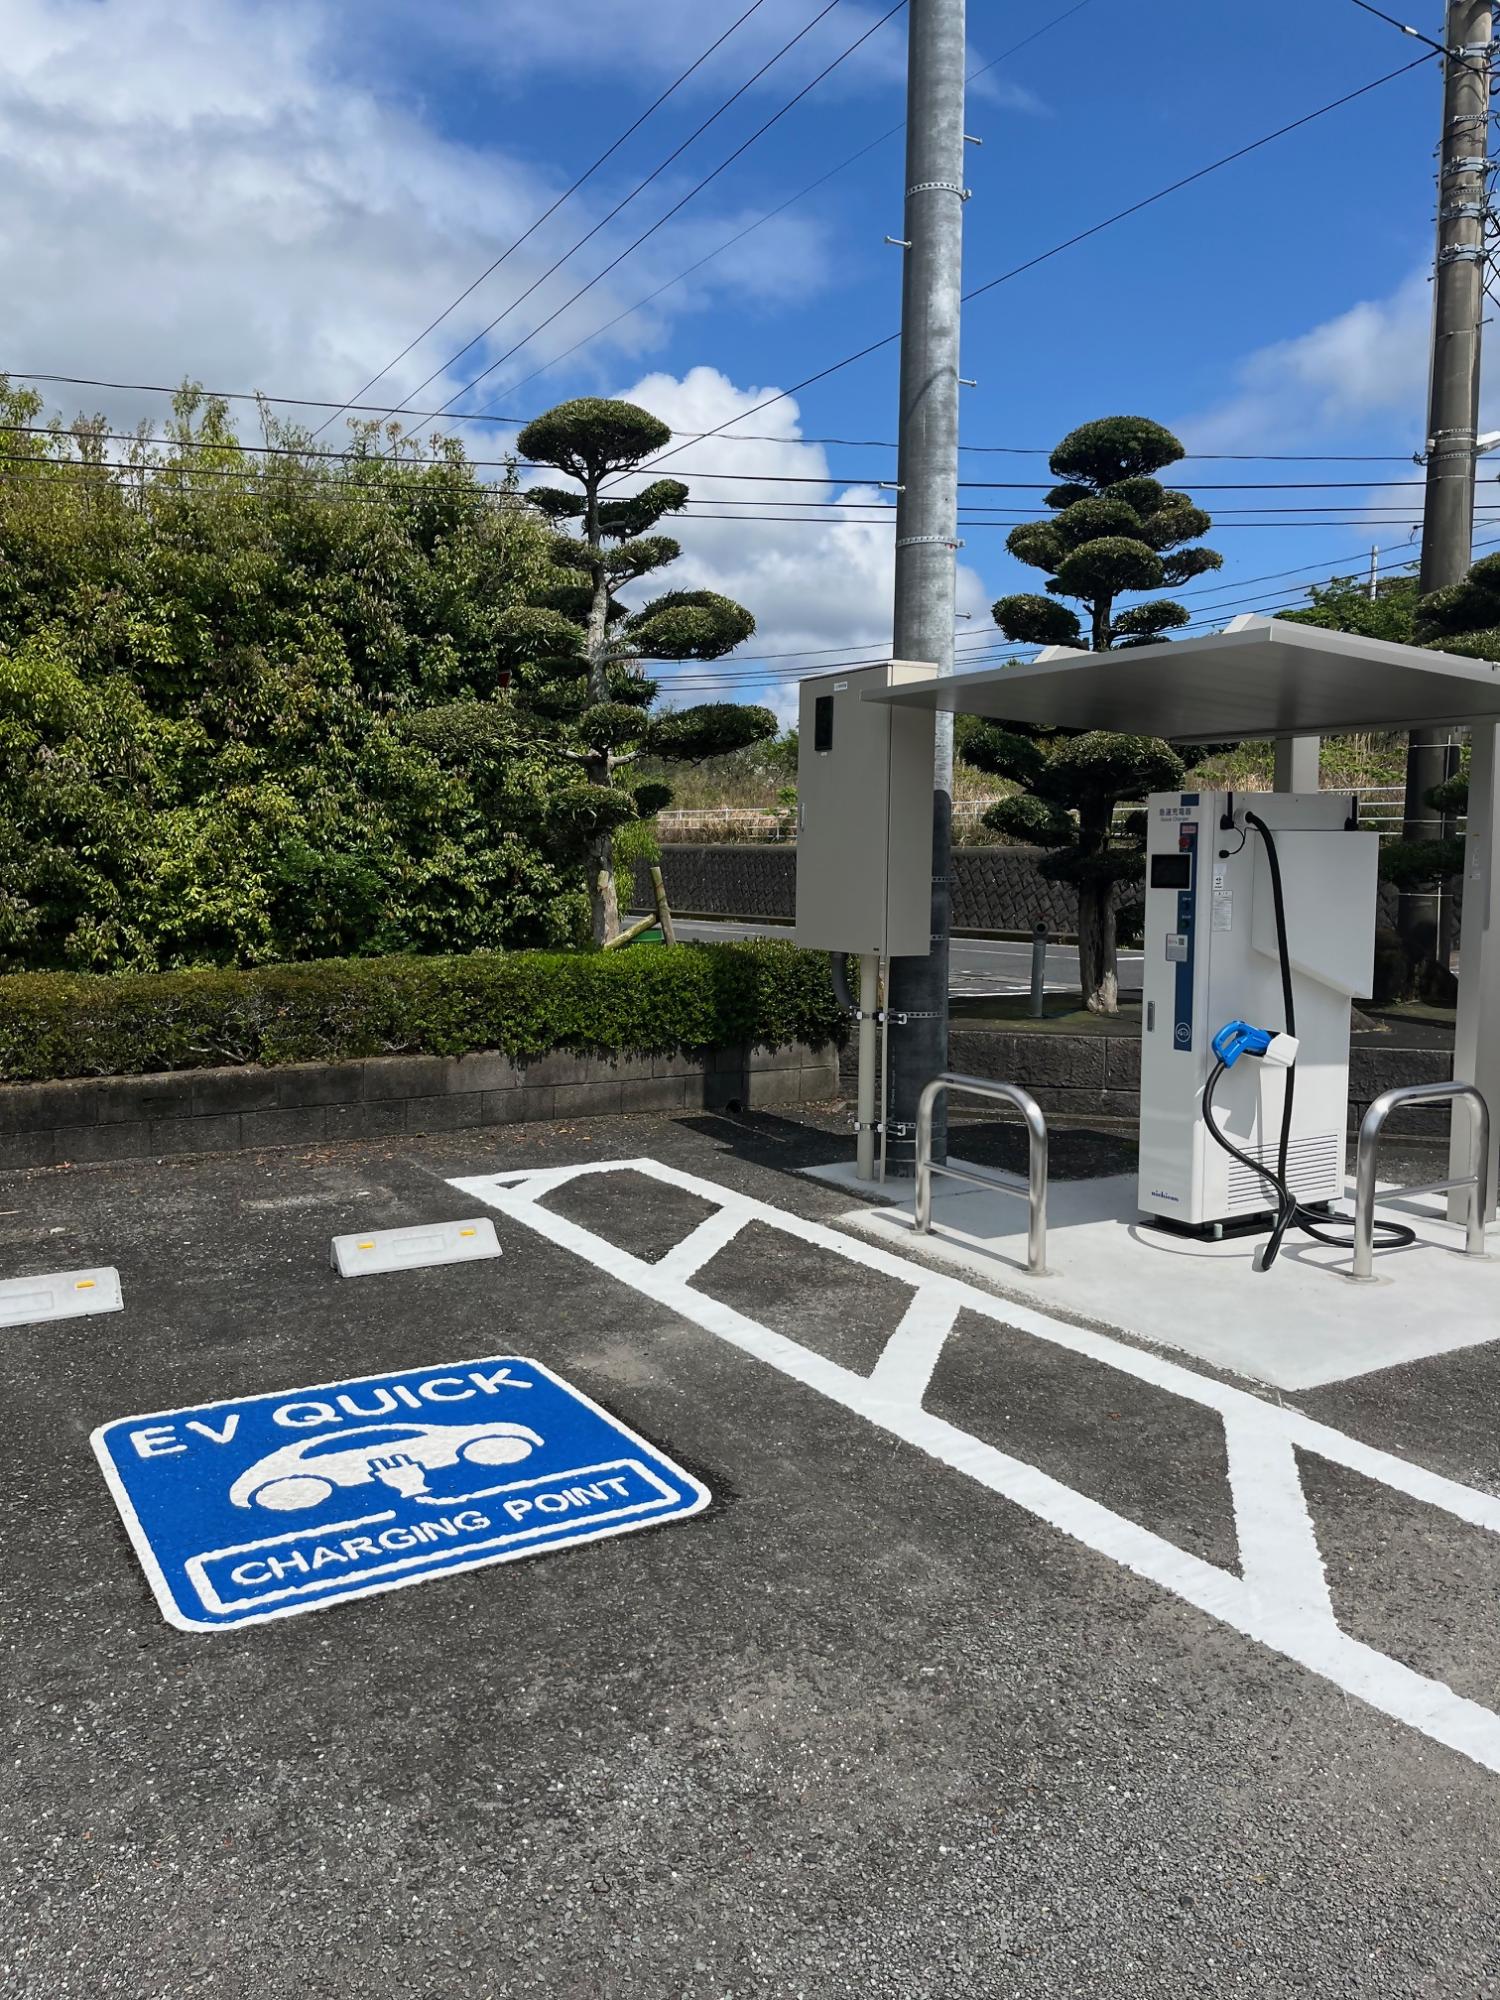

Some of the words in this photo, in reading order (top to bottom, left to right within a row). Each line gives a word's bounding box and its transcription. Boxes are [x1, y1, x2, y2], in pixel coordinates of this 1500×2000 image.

[129, 1414, 240, 1458] EV
[272, 1366, 533, 1428] QUICK
[230, 1510, 491, 1586] CHARGING
[509, 1476, 630, 1522] POINT
